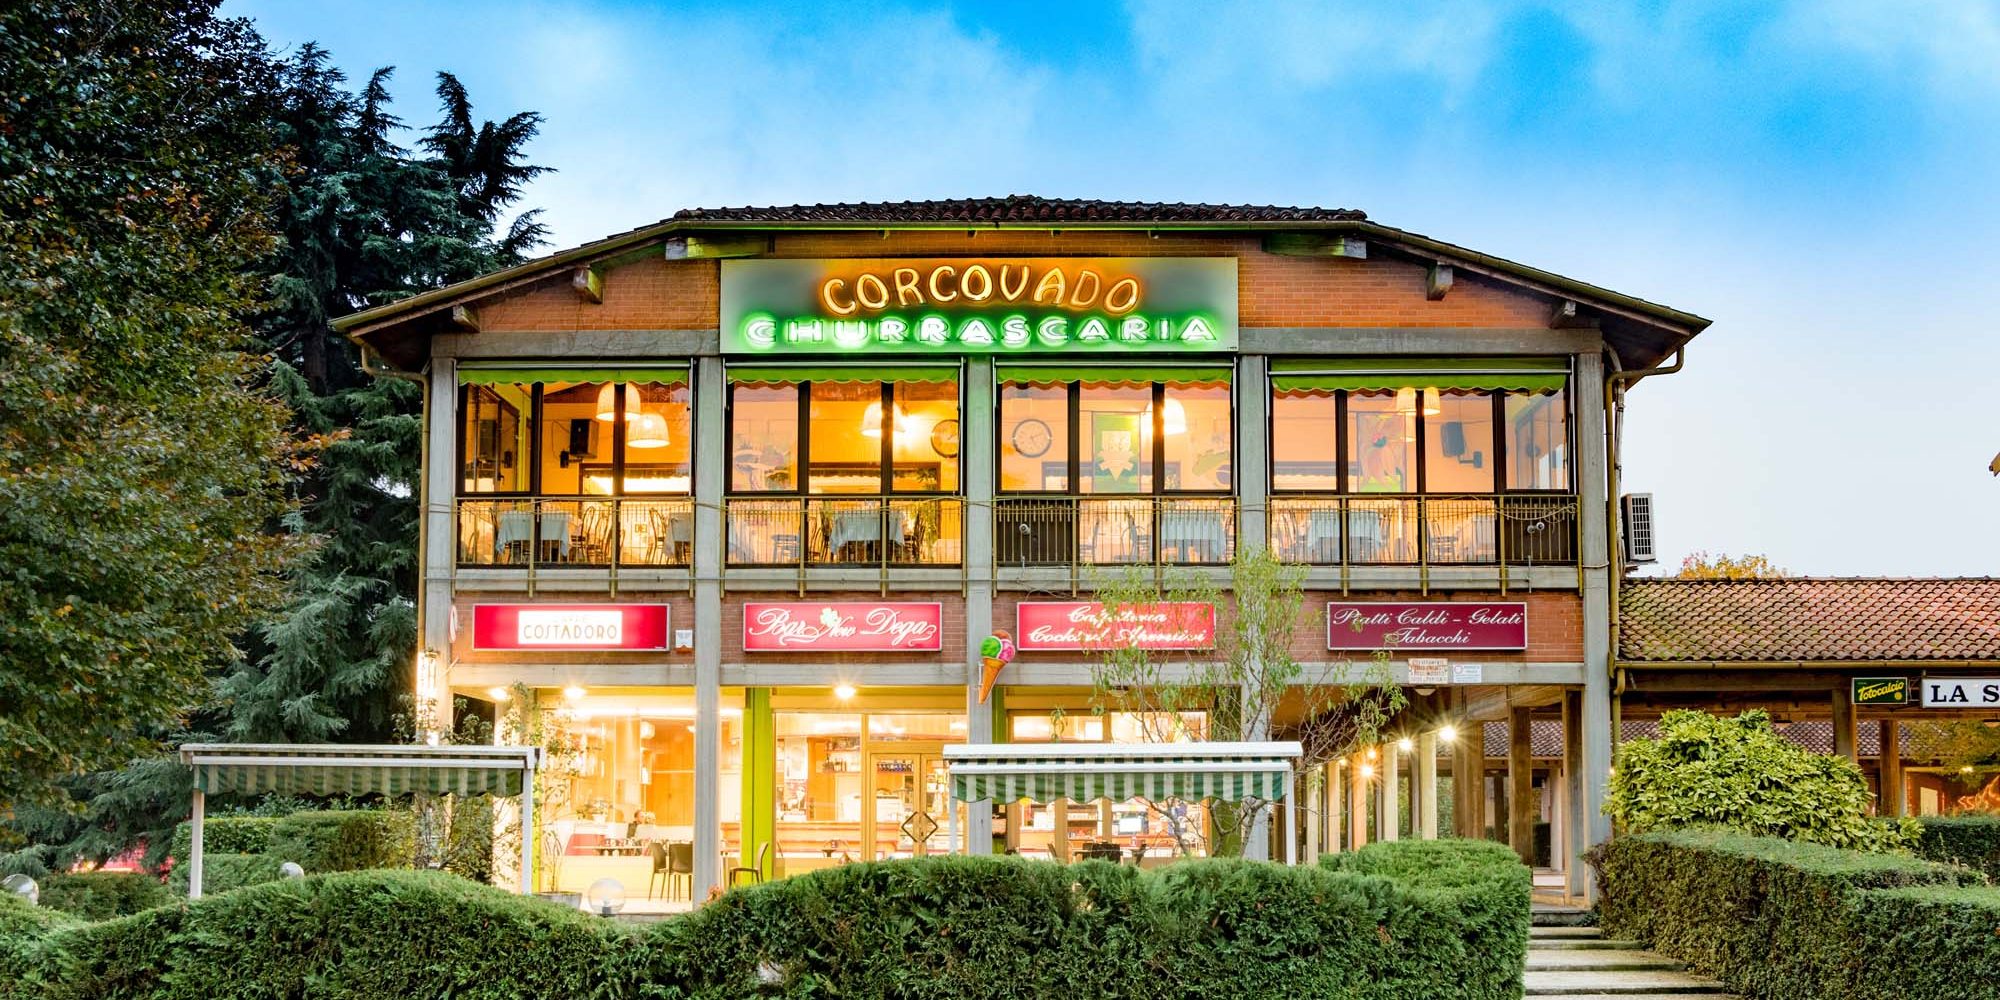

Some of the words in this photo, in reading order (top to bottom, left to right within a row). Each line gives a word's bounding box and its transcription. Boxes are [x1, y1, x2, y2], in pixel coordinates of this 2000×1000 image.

[823, 264, 1140, 314] CORCOVADO
[746, 318, 1218, 347] CHURRASCARIA
[1397, 608, 1449, 625] Caldi
[1468, 608, 1524, 625] Gelati
[523, 624, 617, 639] COSTADORO
[748, 608, 819, 646] Bar
[829, 615, 857, 638] New
[859, 608, 937, 647] Dega
[1387, 627, 1472, 644] Tabacchi
[1857, 680, 1905, 701] Totocalcio
[1930, 685, 1969, 703] LA
[1983, 684, 2000, 703] S
